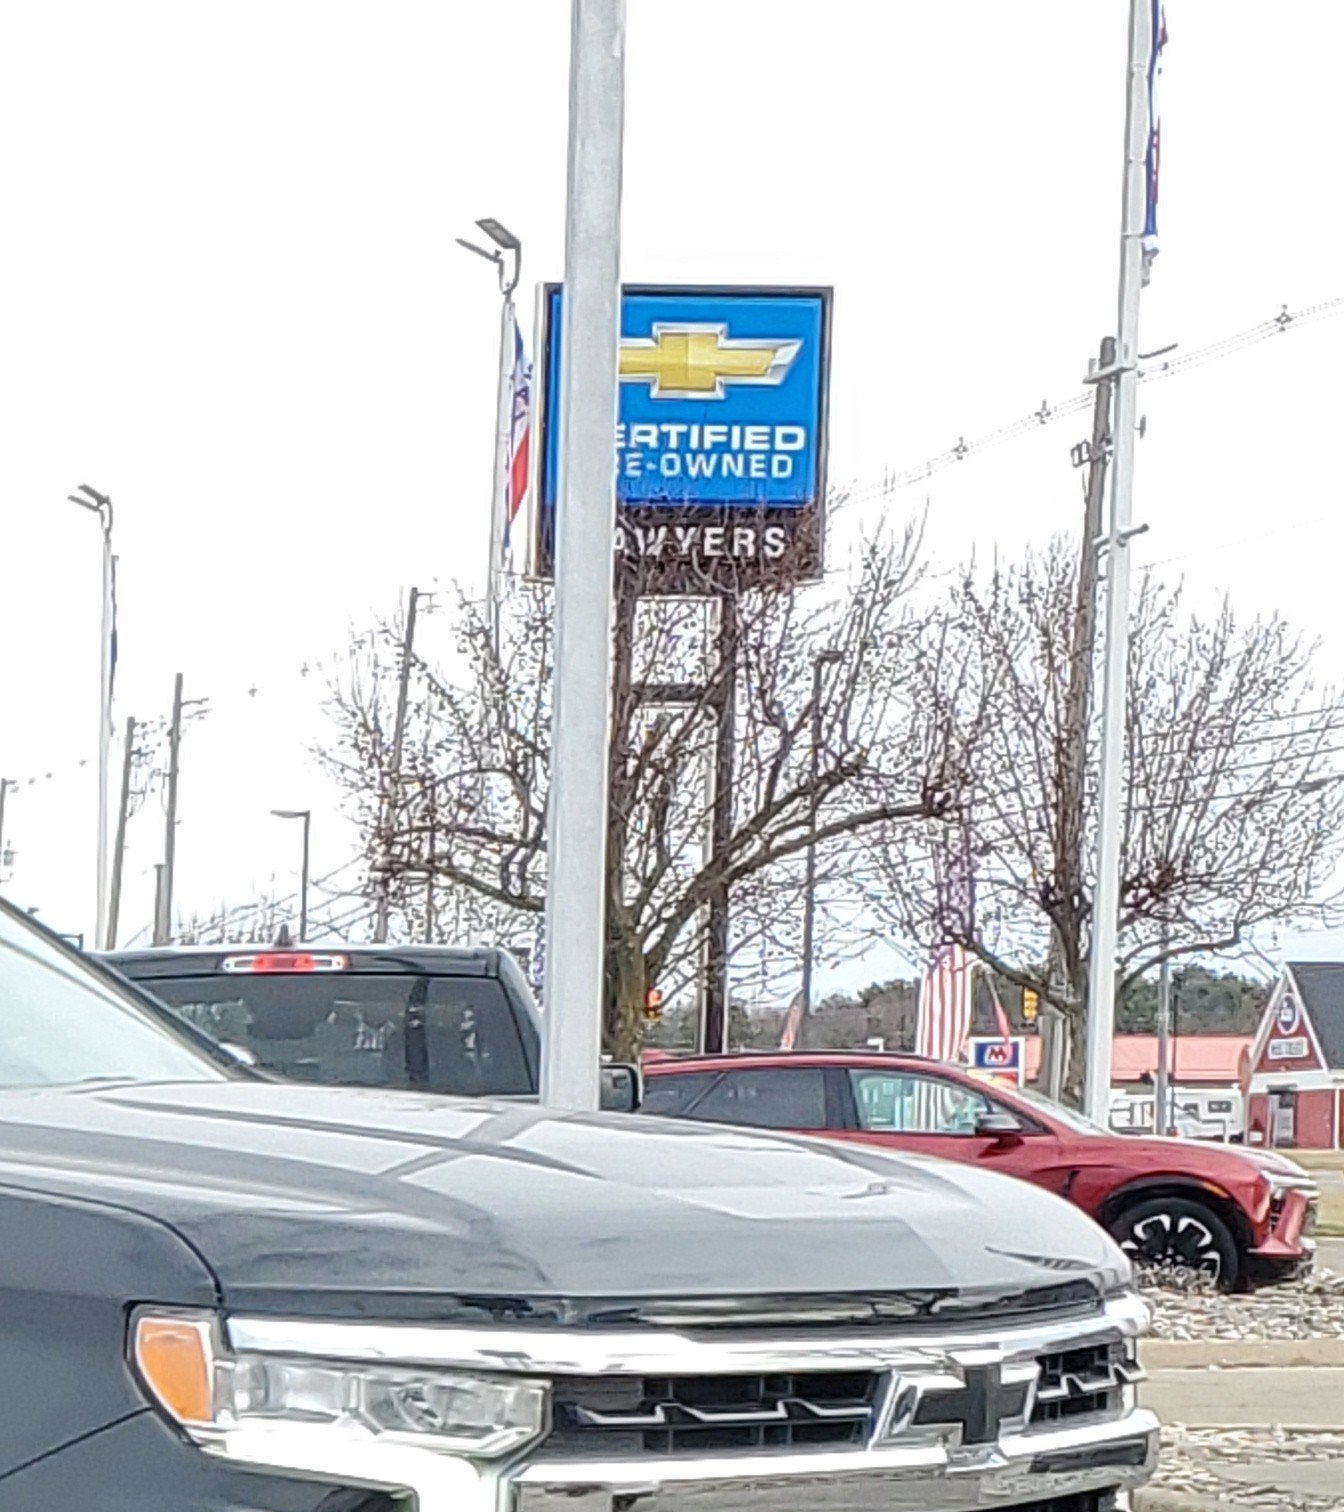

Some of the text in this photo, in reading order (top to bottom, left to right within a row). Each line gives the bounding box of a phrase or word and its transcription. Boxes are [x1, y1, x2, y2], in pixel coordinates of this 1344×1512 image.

[615, 423, 806, 450] RTIFIED
[615, 453, 793, 478] E-OWNED
[614, 526, 786, 558] AWYERS
